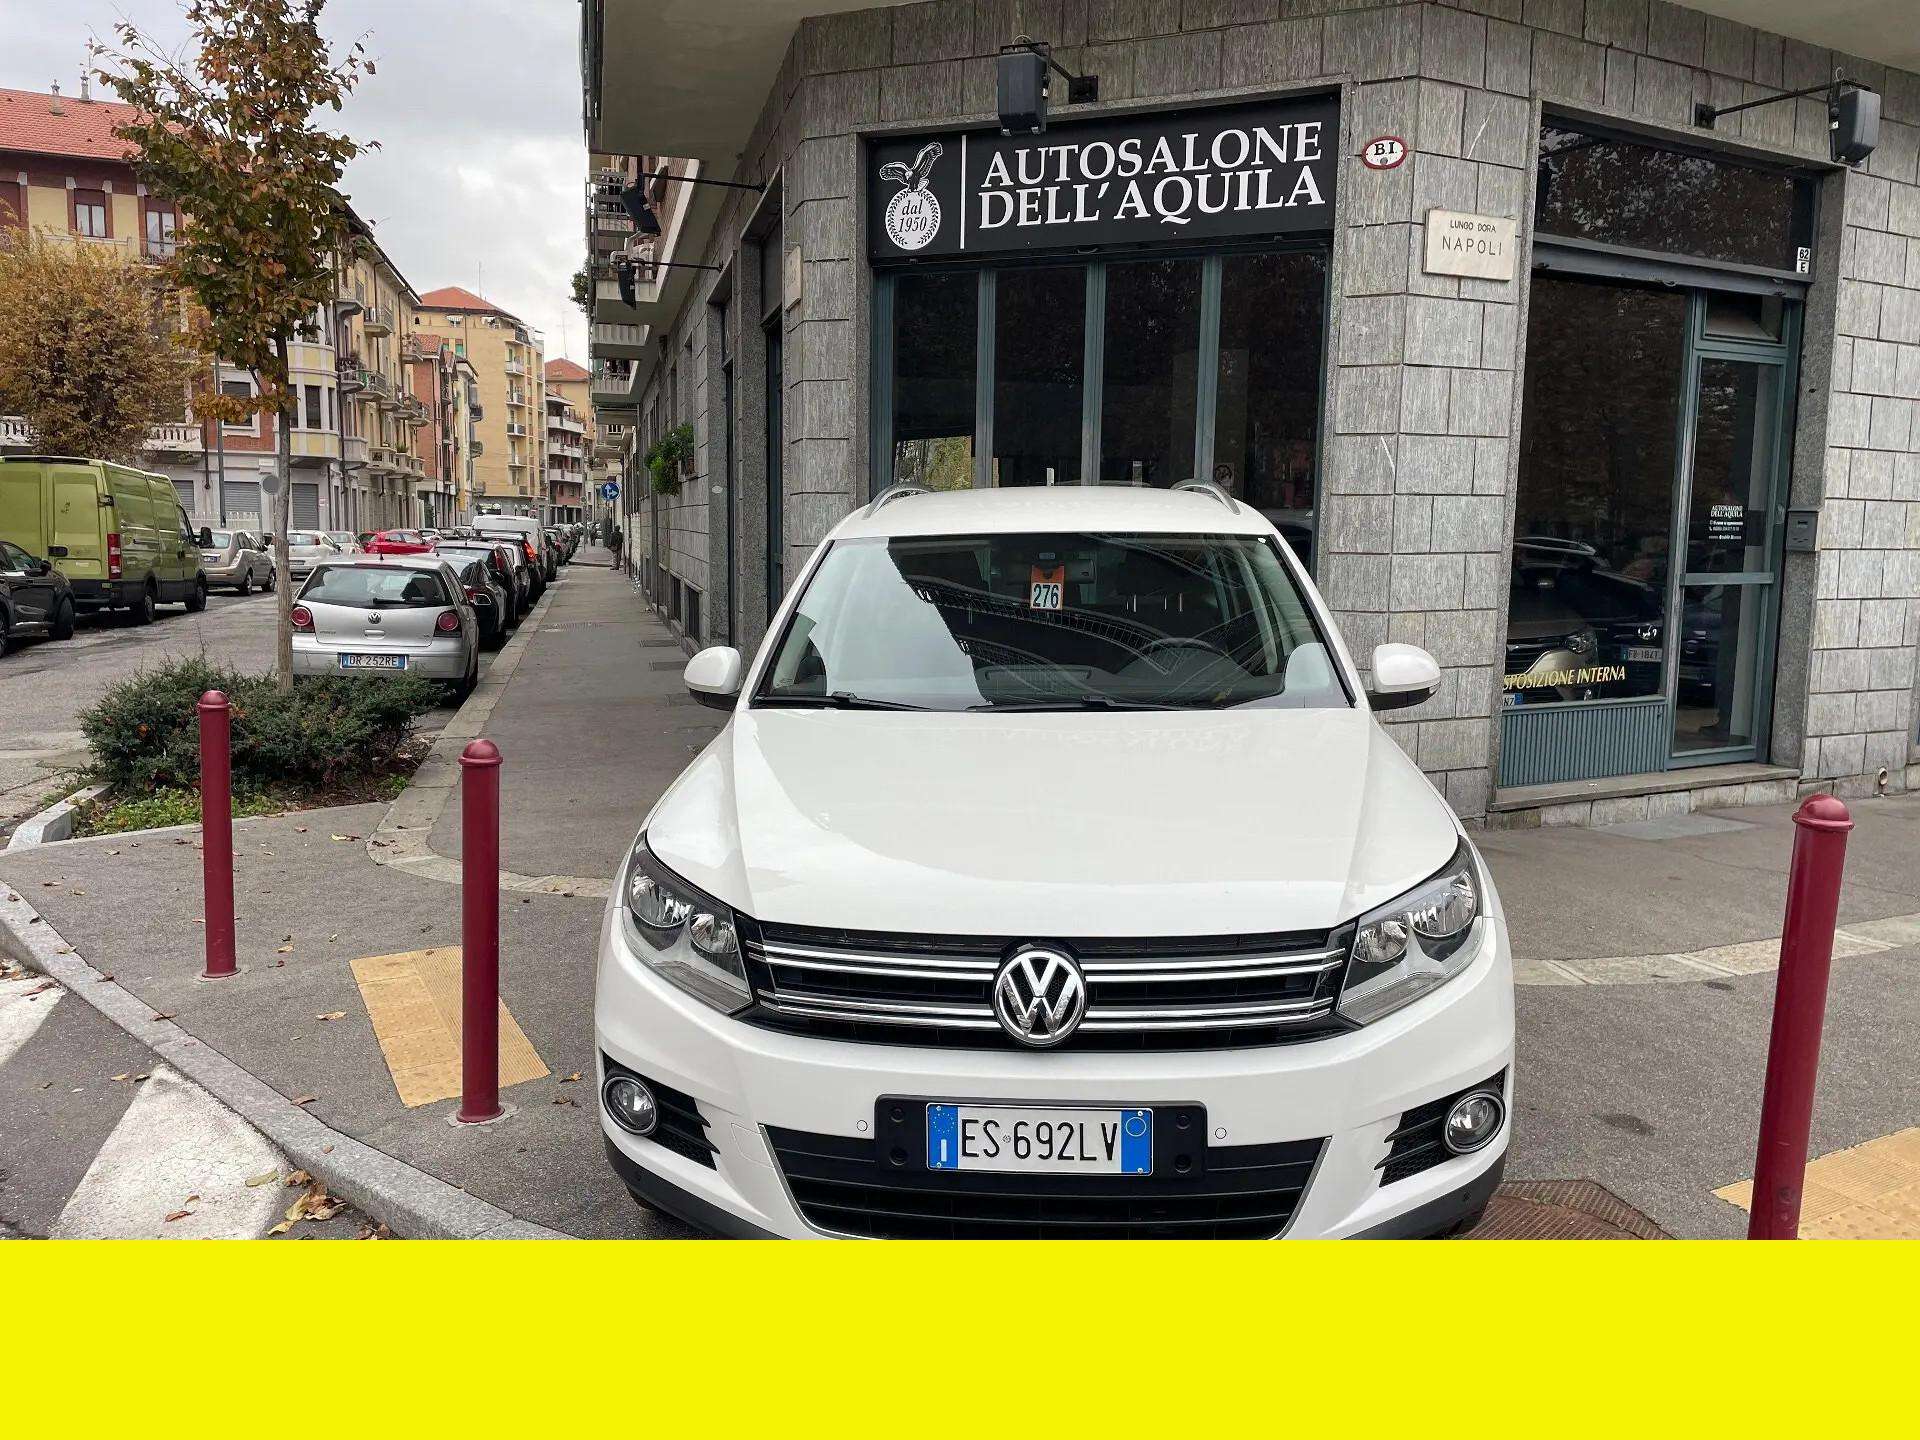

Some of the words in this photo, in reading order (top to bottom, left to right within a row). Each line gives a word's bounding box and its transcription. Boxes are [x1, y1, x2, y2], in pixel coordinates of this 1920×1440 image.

[980, 121, 1323, 188] AUTOSALONE
[978, 164, 1326, 230] DELL'AQUILA
[902, 199, 923, 215] dal
[899, 216, 927, 232] 1950
[1450, 219, 1474, 231] LUNGO
[1477, 223, 1496, 233] DORA
[1442, 235, 1502, 256] NAPOLI
[1800, 249, 1809, 259] 62
[1800, 262, 1806, 272] E
[1033, 584, 1059, 609] 276
[350, 655, 362, 665] DR
[365, 655, 398, 666] 252RE
[1503, 669, 1575, 691] SPOSIZIONE
[1576, 665, 1626, 684] INTERNA
[961, 1119, 1000, 1158] ES
[1013, 1120, 1118, 1161] 692LV
